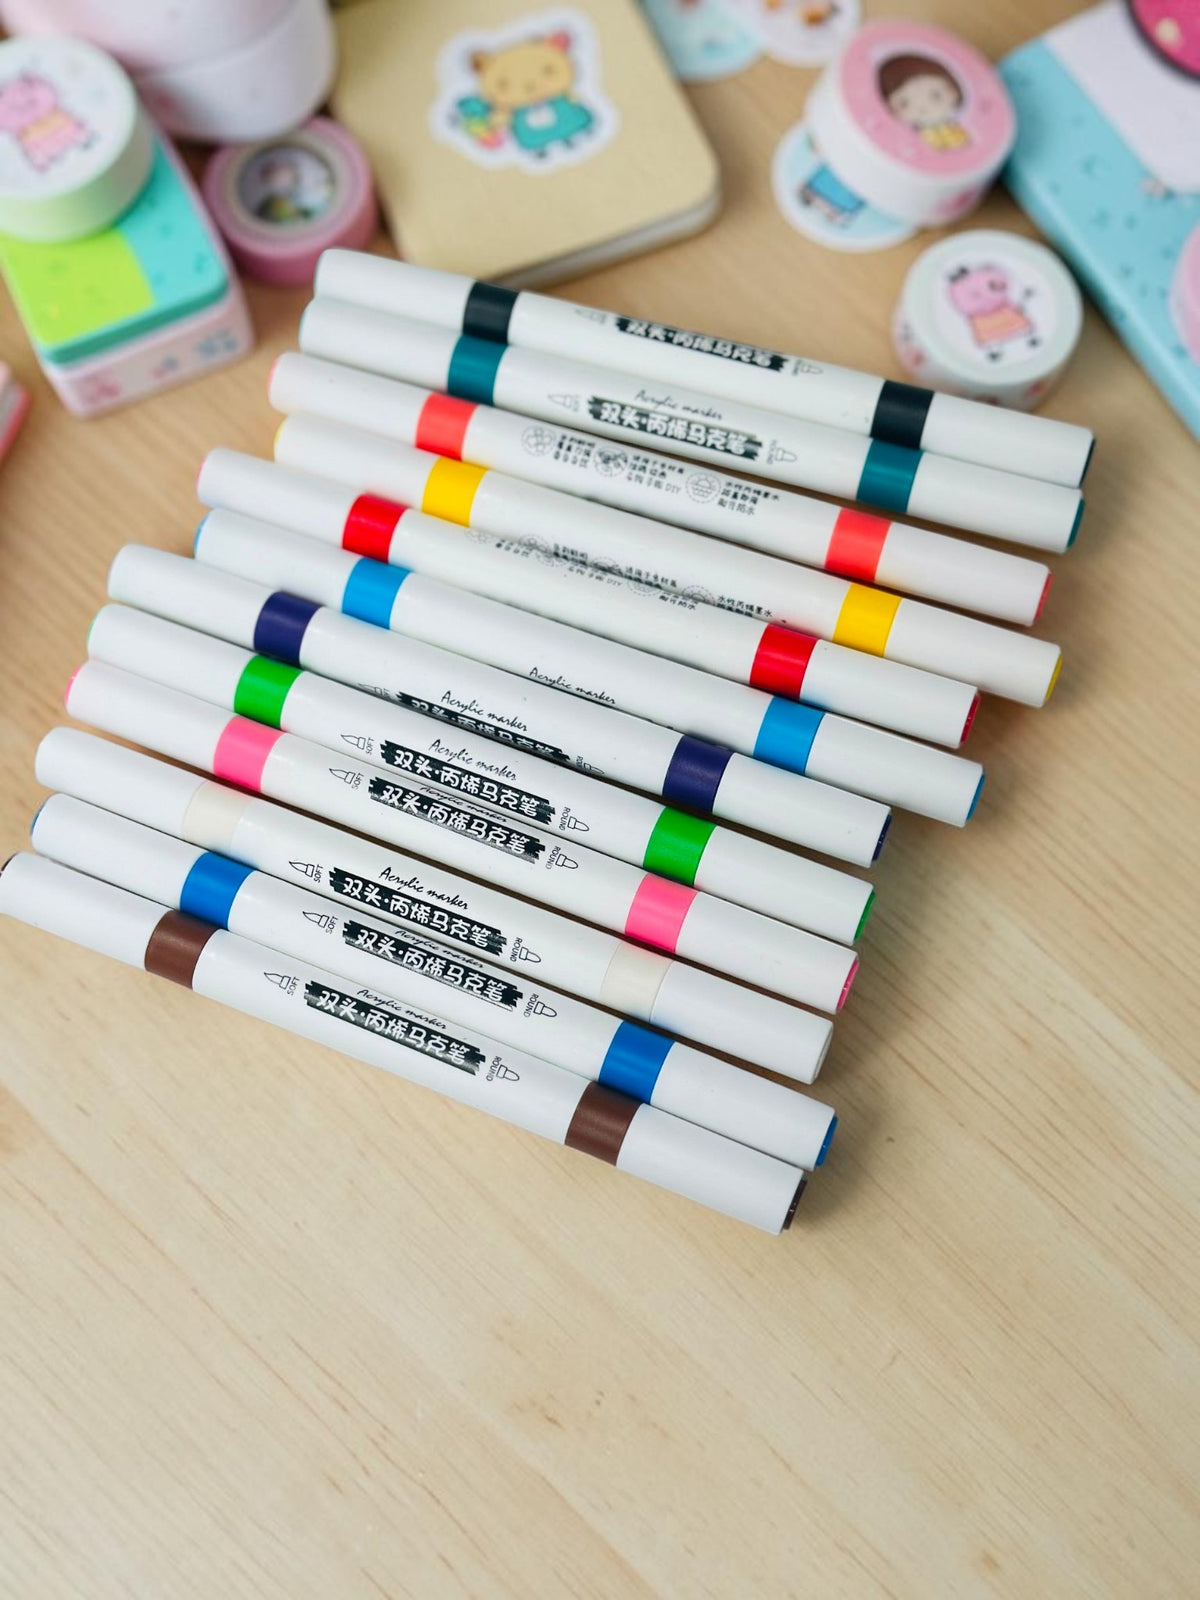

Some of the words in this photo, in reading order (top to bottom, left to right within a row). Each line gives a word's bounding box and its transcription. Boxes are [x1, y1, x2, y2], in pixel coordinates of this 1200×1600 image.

[529, 667, 572, 689] Acrylic
[575, 686, 616, 705] marker
[441, 690, 484, 716] Acrylic
[488, 711, 528, 732] marker
[429, 738, 473, 763] Acrylic
[475, 760, 518, 781] marker
[352, 773, 365, 790] SOFT
[559, 806, 571, 831] ROUND
[545, 845, 561, 870] ROUND
[313, 864, 325, 883] SOFT
[379, 866, 424, 894] Acrylic
[427, 889, 469, 910] marker
[325, 916, 339, 934] SOFT
[395, 930, 440, 951] Acrylic
[442, 949, 483, 968] marker
[509, 936, 523, 962] ROUND
[286, 978, 300, 996] SOFT
[356, 988, 402, 1013] Acrylic
[405, 1008, 447, 1029] marker
[523, 992, 538, 1018] ROUND
[486, 1055, 502, 1082] ROUND
